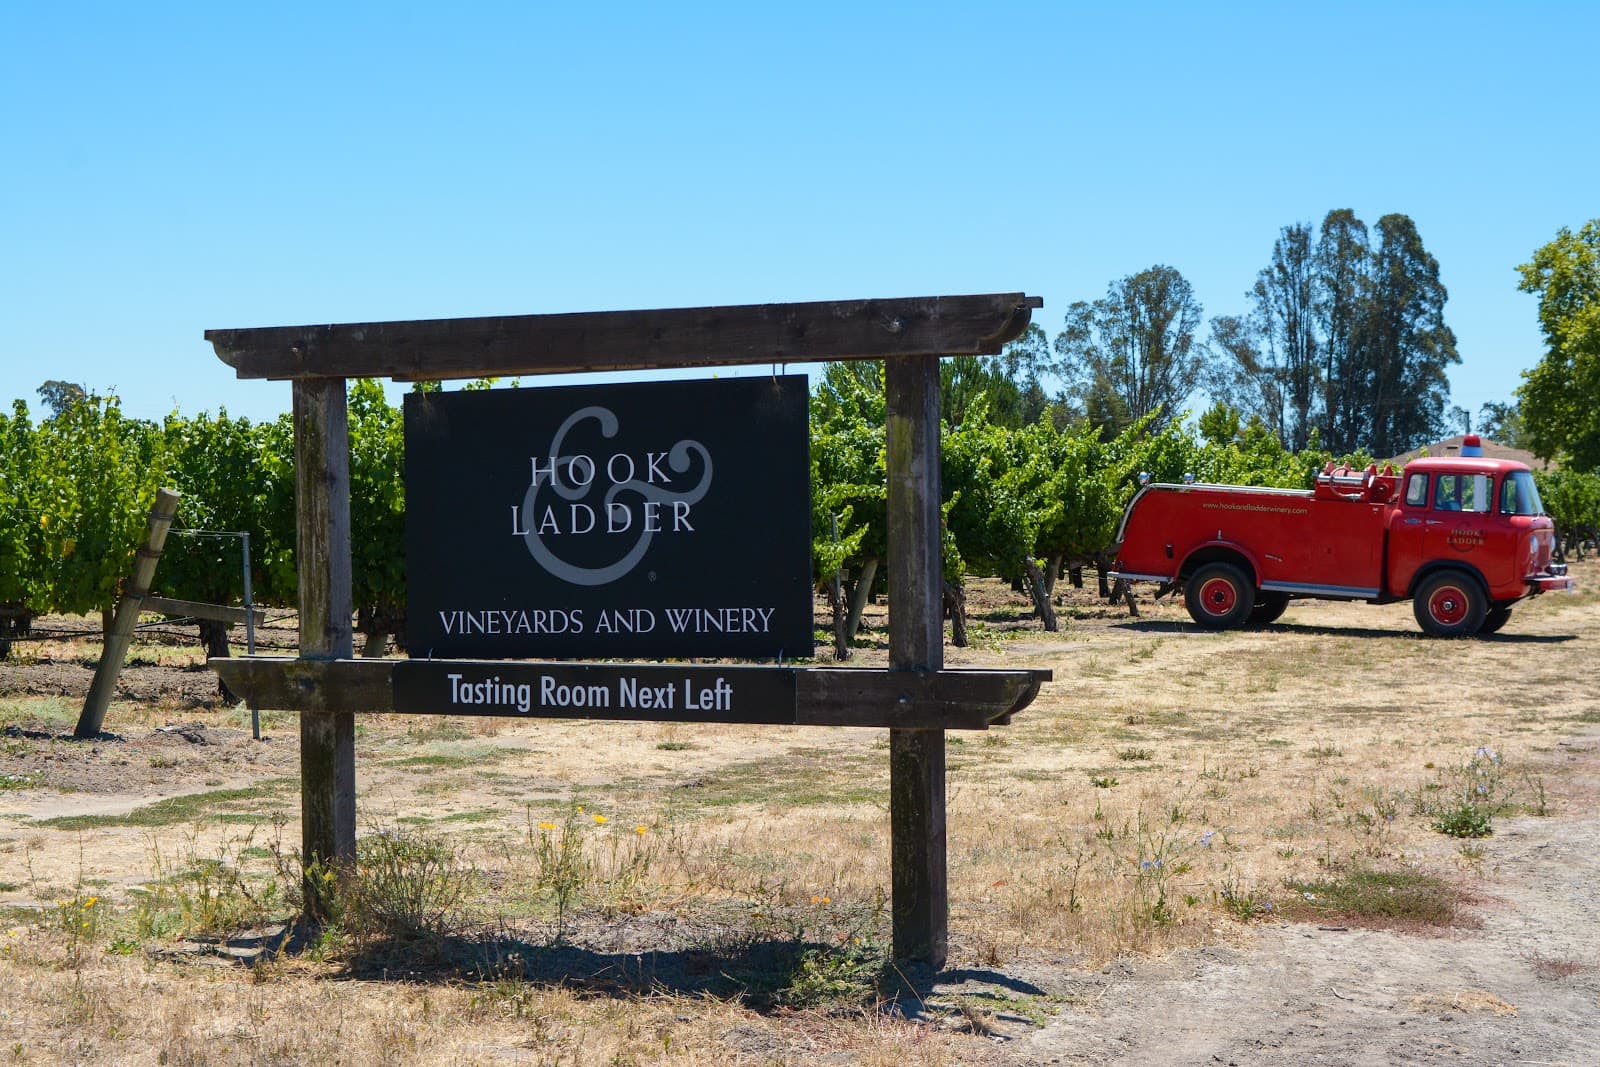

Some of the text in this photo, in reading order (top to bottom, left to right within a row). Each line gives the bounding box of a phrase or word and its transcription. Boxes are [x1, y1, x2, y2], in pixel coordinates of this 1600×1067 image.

[531, 453, 671, 487] HOOK
[511, 500, 694, 535] LADDER
[1202, 502, 1308, 515] www.hookandladderwinery.com
[1446, 536, 1485, 546] LADDER
[1450, 529, 1480, 537] HOOK
[439, 607, 775, 634] VINEYARDS AND WINERY
[448, 673, 733, 713] Tasting Room Next Left
